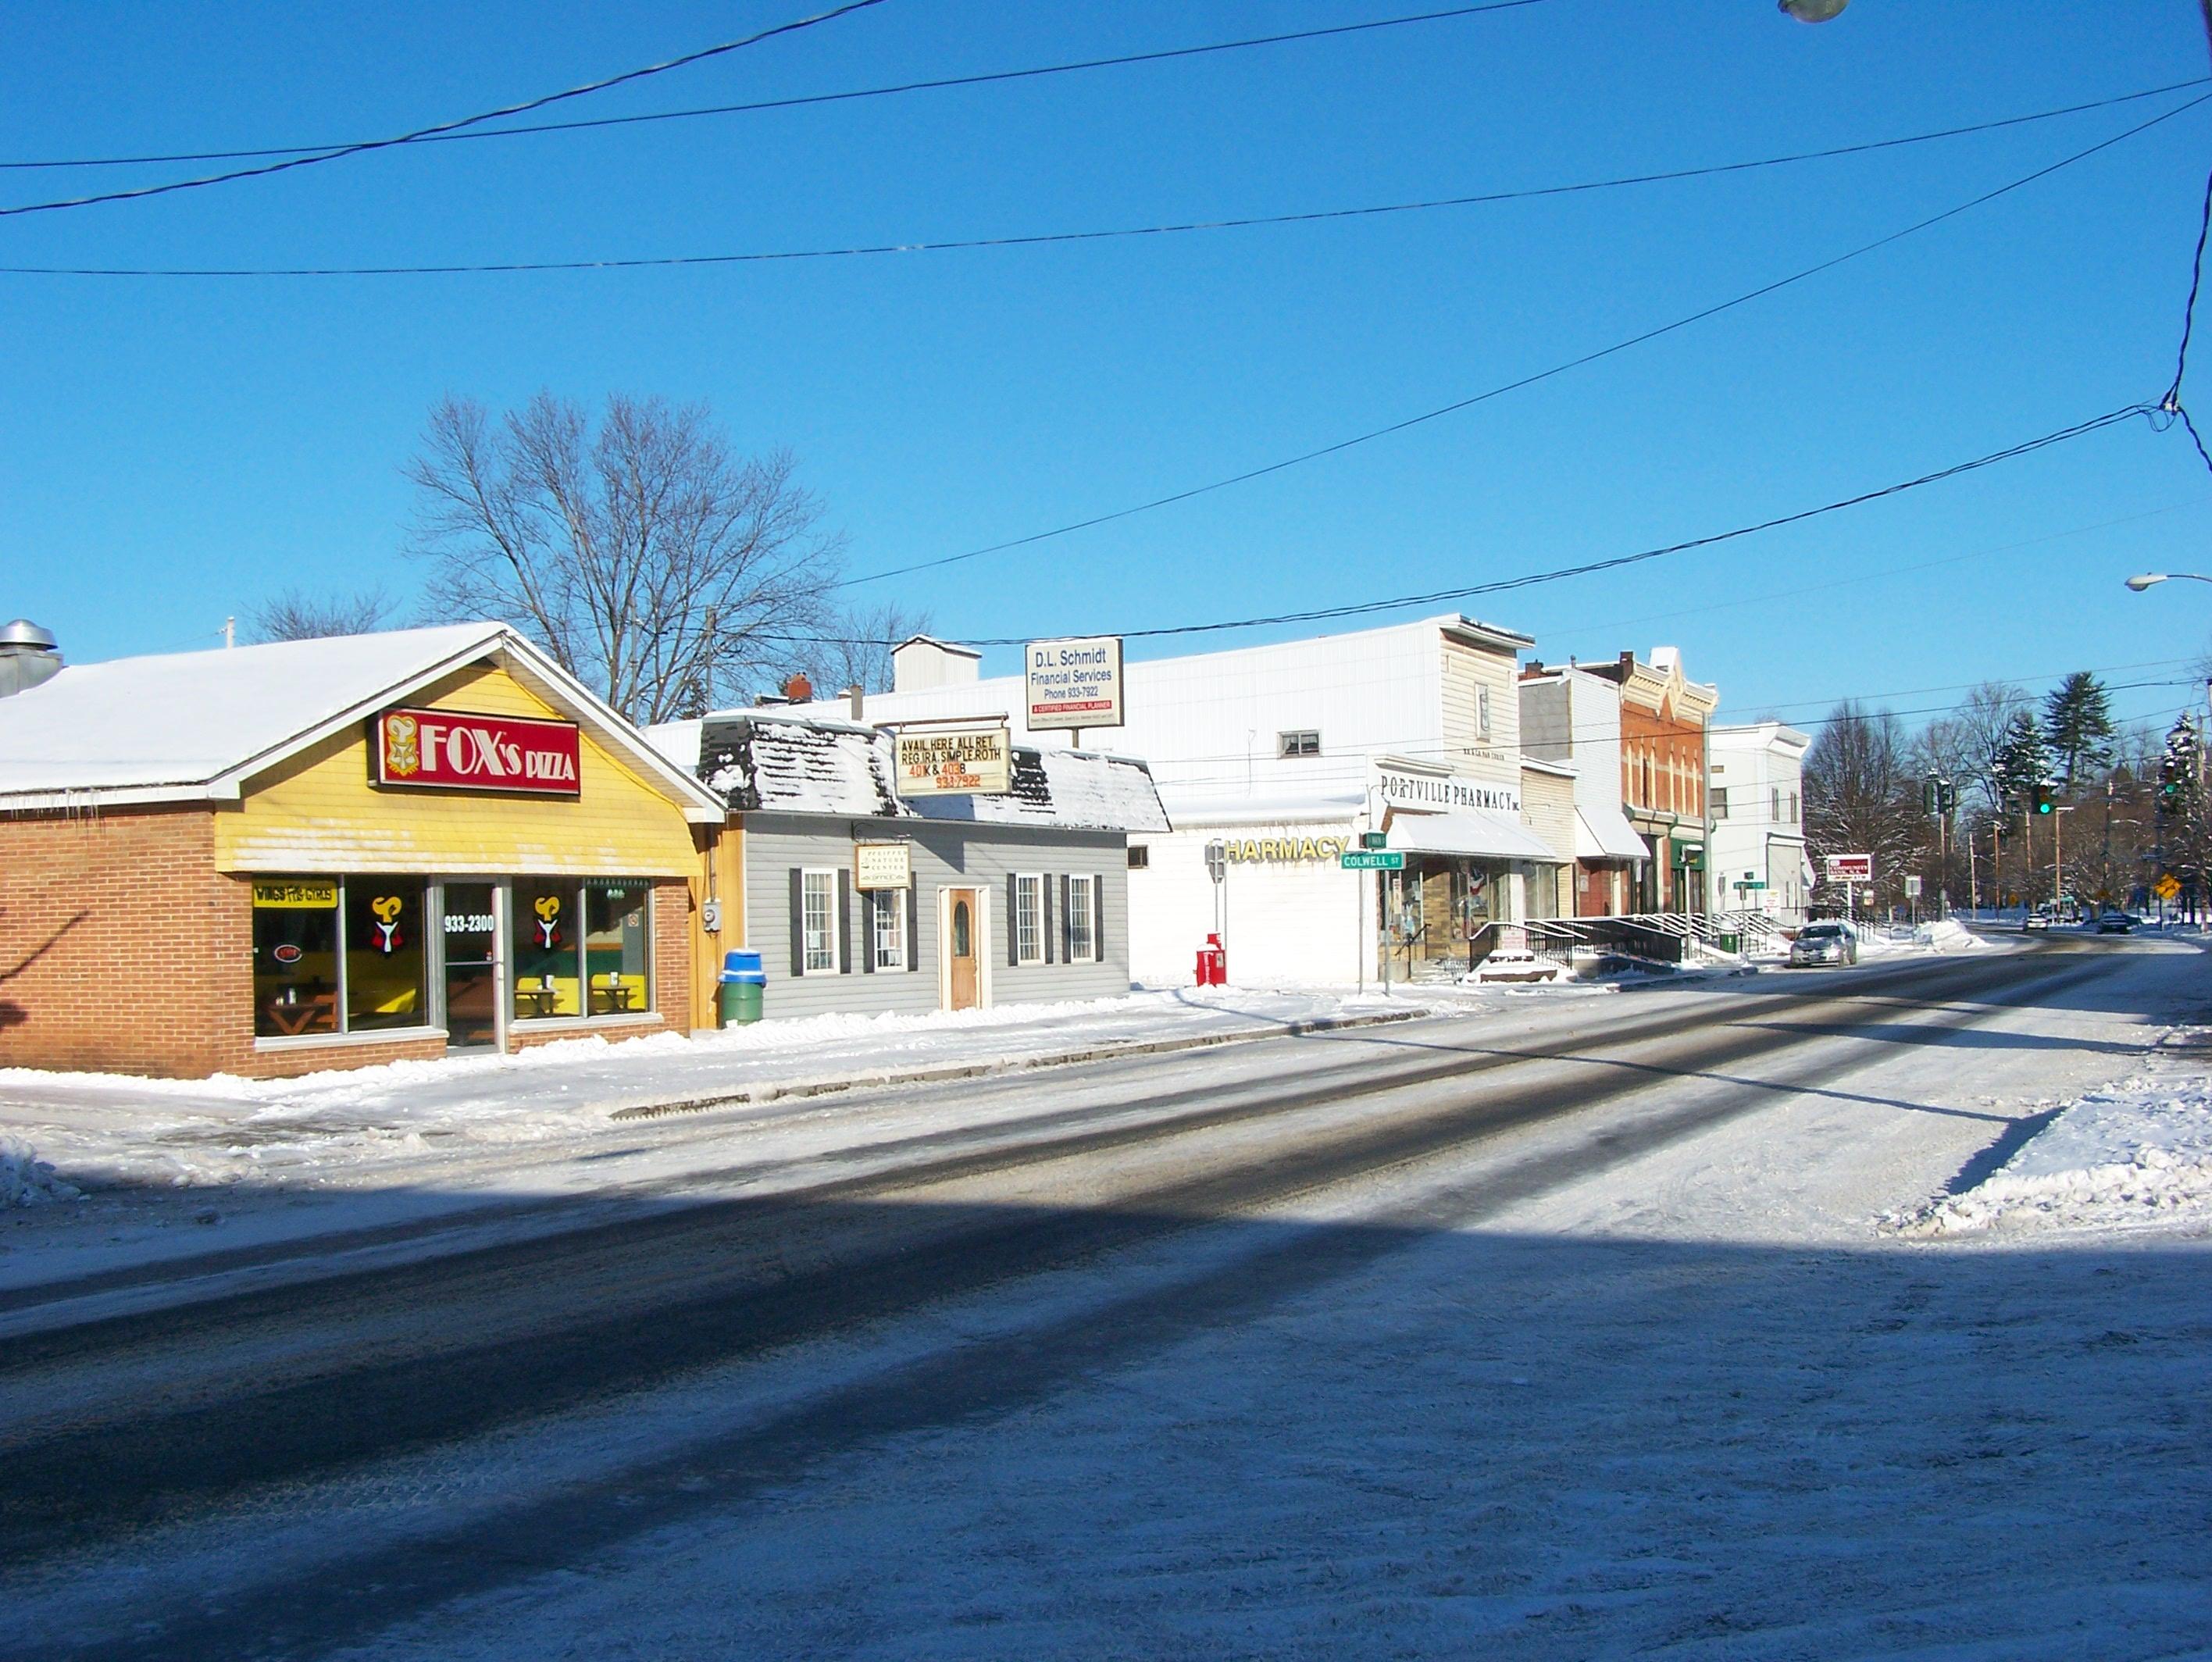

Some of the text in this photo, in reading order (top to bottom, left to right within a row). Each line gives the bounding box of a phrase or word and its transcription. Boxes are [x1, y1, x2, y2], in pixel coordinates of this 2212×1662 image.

[1035, 647, 1107, 668] D.L. Schmidt
[1031, 669, 1112, 686] Financial Services
[1044, 686, 1098, 700] Phone 933-7922
[1063, 702, 1087, 712] FINANCIAL
[1087, 701, 1110, 710] PLANNER
[526, 751, 576, 781] PIZZA
[932, 765, 940, 775] &
[1381, 775, 1450, 804] PORTVILLE
[1454, 786, 1512, 811] PHARMACY
[1343, 855, 1389, 867] COLWELL
[444, 915, 494, 933] 933-2300
